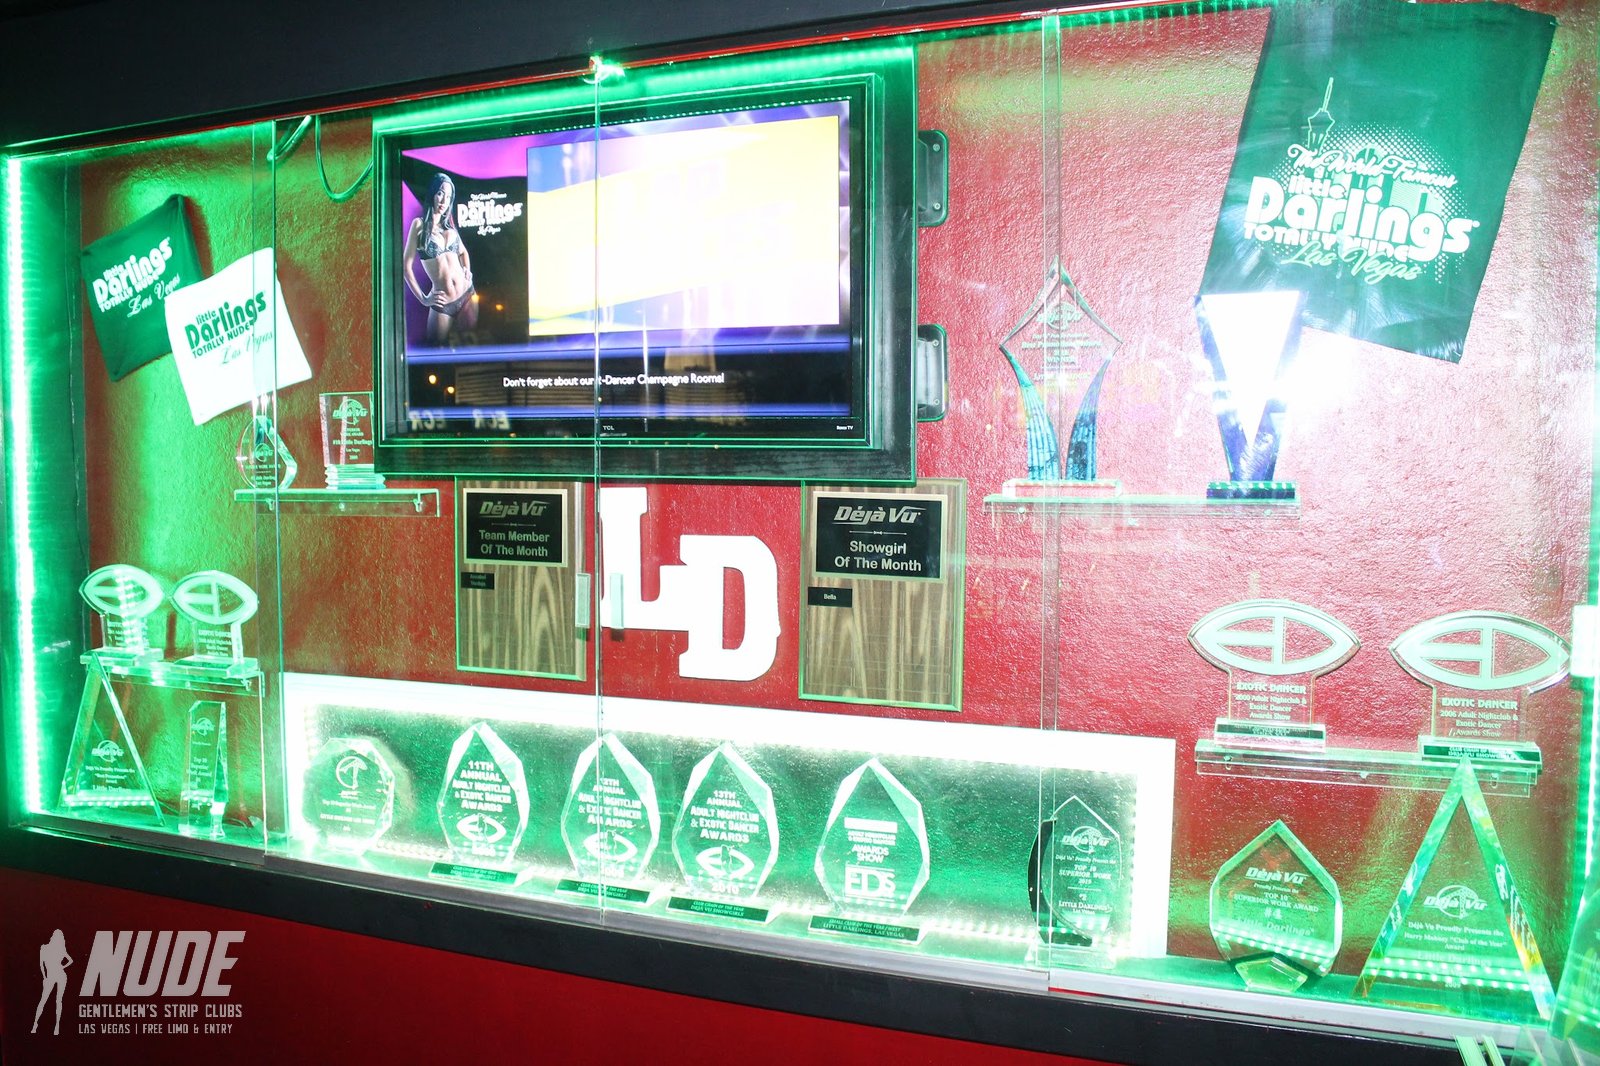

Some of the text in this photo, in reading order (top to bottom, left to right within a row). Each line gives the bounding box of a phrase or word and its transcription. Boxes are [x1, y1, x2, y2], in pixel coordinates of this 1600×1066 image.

[1326, 150, 1394, 177] World
[1381, 153, 1458, 188] Famous
[1288, 175, 1347, 199] little
[1245, 176, 1480, 262] Darlings
[1243, 221, 1337, 250] TOTALLY
[92, 237, 173, 300] Darlings
[1281, 239, 1422, 285] Las Vegas
[99, 289, 133, 312] TOTALLY
[127, 274, 181, 318] Las Vegas
[184, 290, 267, 350] Darlings
[196, 309, 217, 324] little
[192, 320, 252, 359] TOTALLY NUDE
[220, 347, 241, 365] Las
[503, 372, 725, 389] Don't forget about our Champagne Rooms!
[479, 500, 550, 519] Déjà Vu
[832, 505, 927, 526] Déjà Vu
[479, 530, 550, 543] Team Member
[481, 543, 548, 557] Of The Month
[849, 540, 907, 557] Showgirl
[834, 556, 922, 572] Of The Month
[1441, 697, 1518, 710] EXOTIC DANCER
[467, 760, 494, 771] 11TH
[460, 770, 502, 783] ANNUAL
[706, 797, 742, 808] ANNUAL
[713, 789, 736, 800] 13TH
[613, 806, 642, 820] DANCER
[690, 806, 760, 823] ADULT NIGHTCLUB
[690, 817, 760, 834] & EXOTIC DANCER
[851, 843, 890, 857] AWARDS
[856, 851, 884, 864] SHOW
[845, 866, 896, 899] EDS
[1058, 869, 1112, 881] SUPERIOR WORK
[1245, 866, 1309, 885] Déjà Vu
[1264, 891, 1278, 899] TOP
[1271, 899, 1291, 909] WORK
[1292, 902, 1319, 913] AWARD
[823, 922, 842, 930] LITTLE
[1424, 921, 1434, 930] Vu
[1435, 922, 1462, 934] Proudly
[1463, 926, 1493, 936] Presents
[1493, 929, 1504, 937] the
[1444, 943, 1465, 951] Award
[1470, 936, 1477, 945] of
[1477, 938, 1488, 946] the
